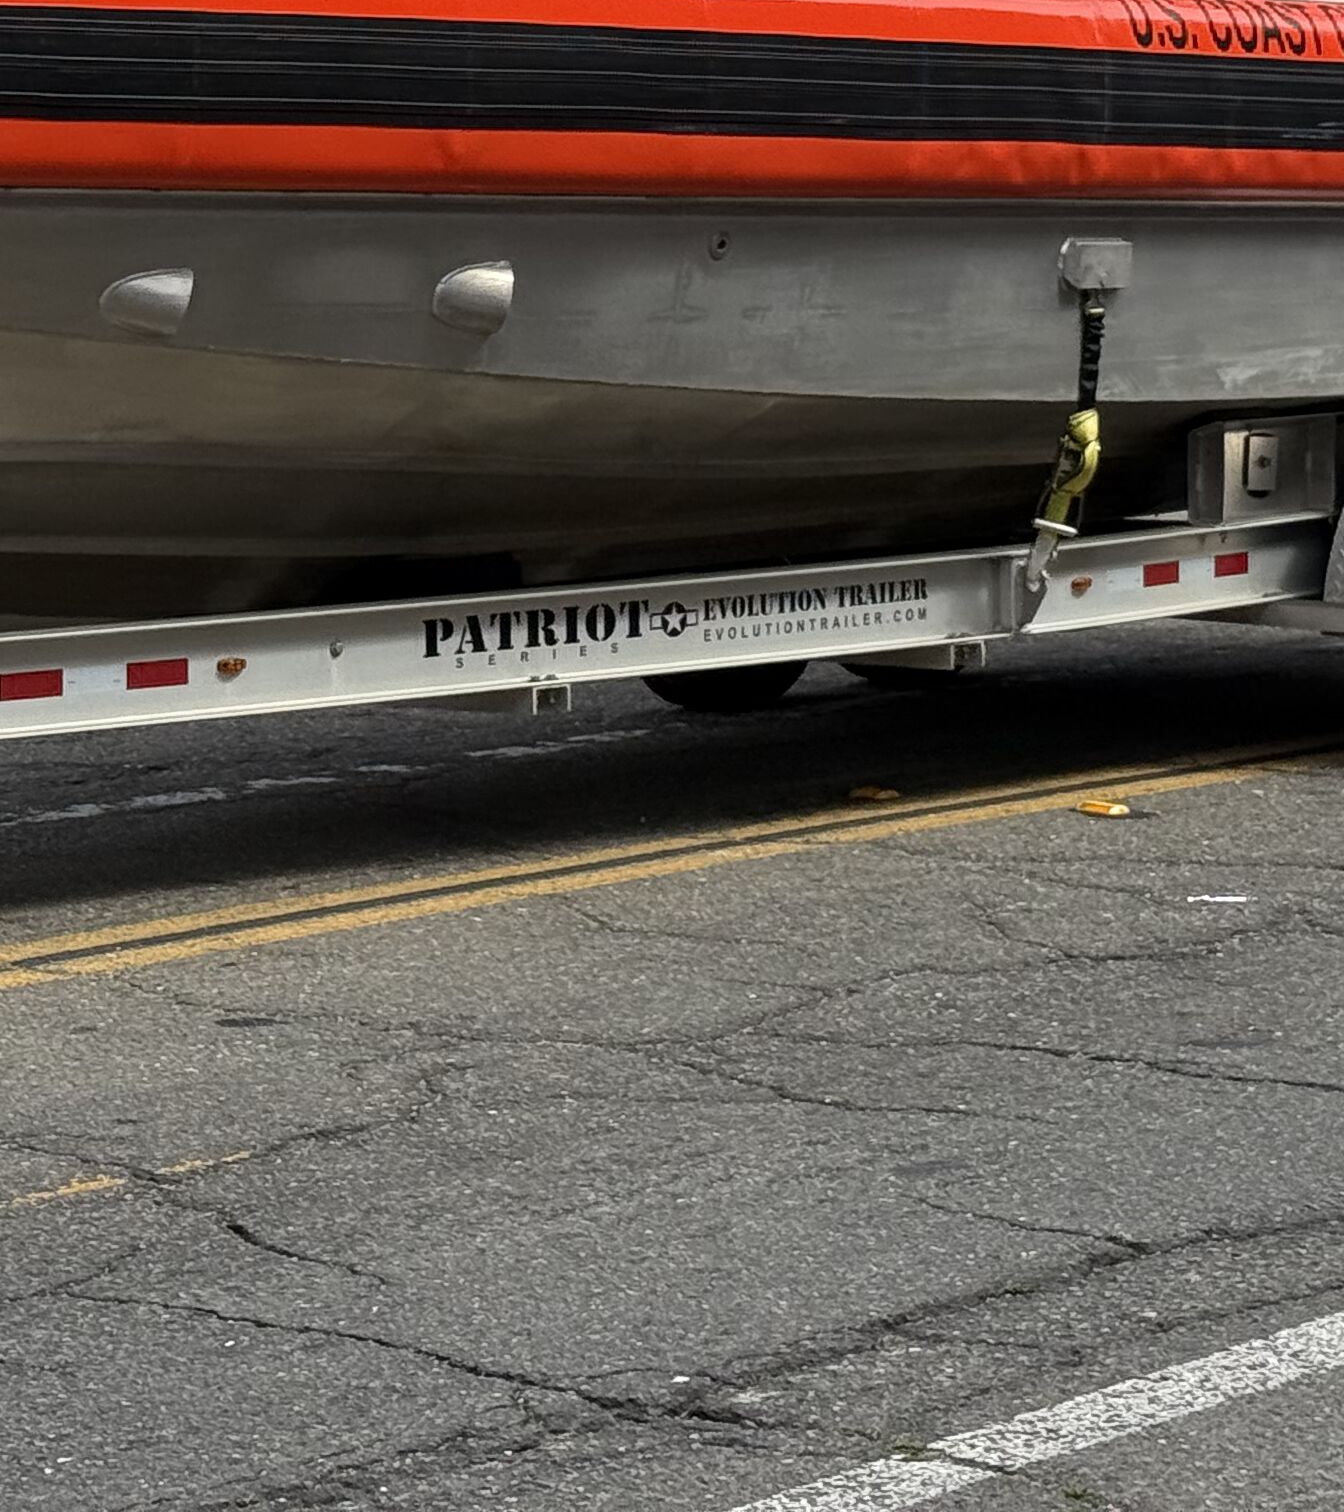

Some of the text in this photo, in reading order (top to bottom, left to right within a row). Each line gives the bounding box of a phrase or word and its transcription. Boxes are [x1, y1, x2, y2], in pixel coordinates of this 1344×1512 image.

[703, 578, 928, 622] EVOLUTION TRAILER
[422, 599, 650, 659] PATRIOT
[703, 607, 928, 642] EVOLUTIONTRAILER.COM
[455, 641, 619, 669] SERIES
